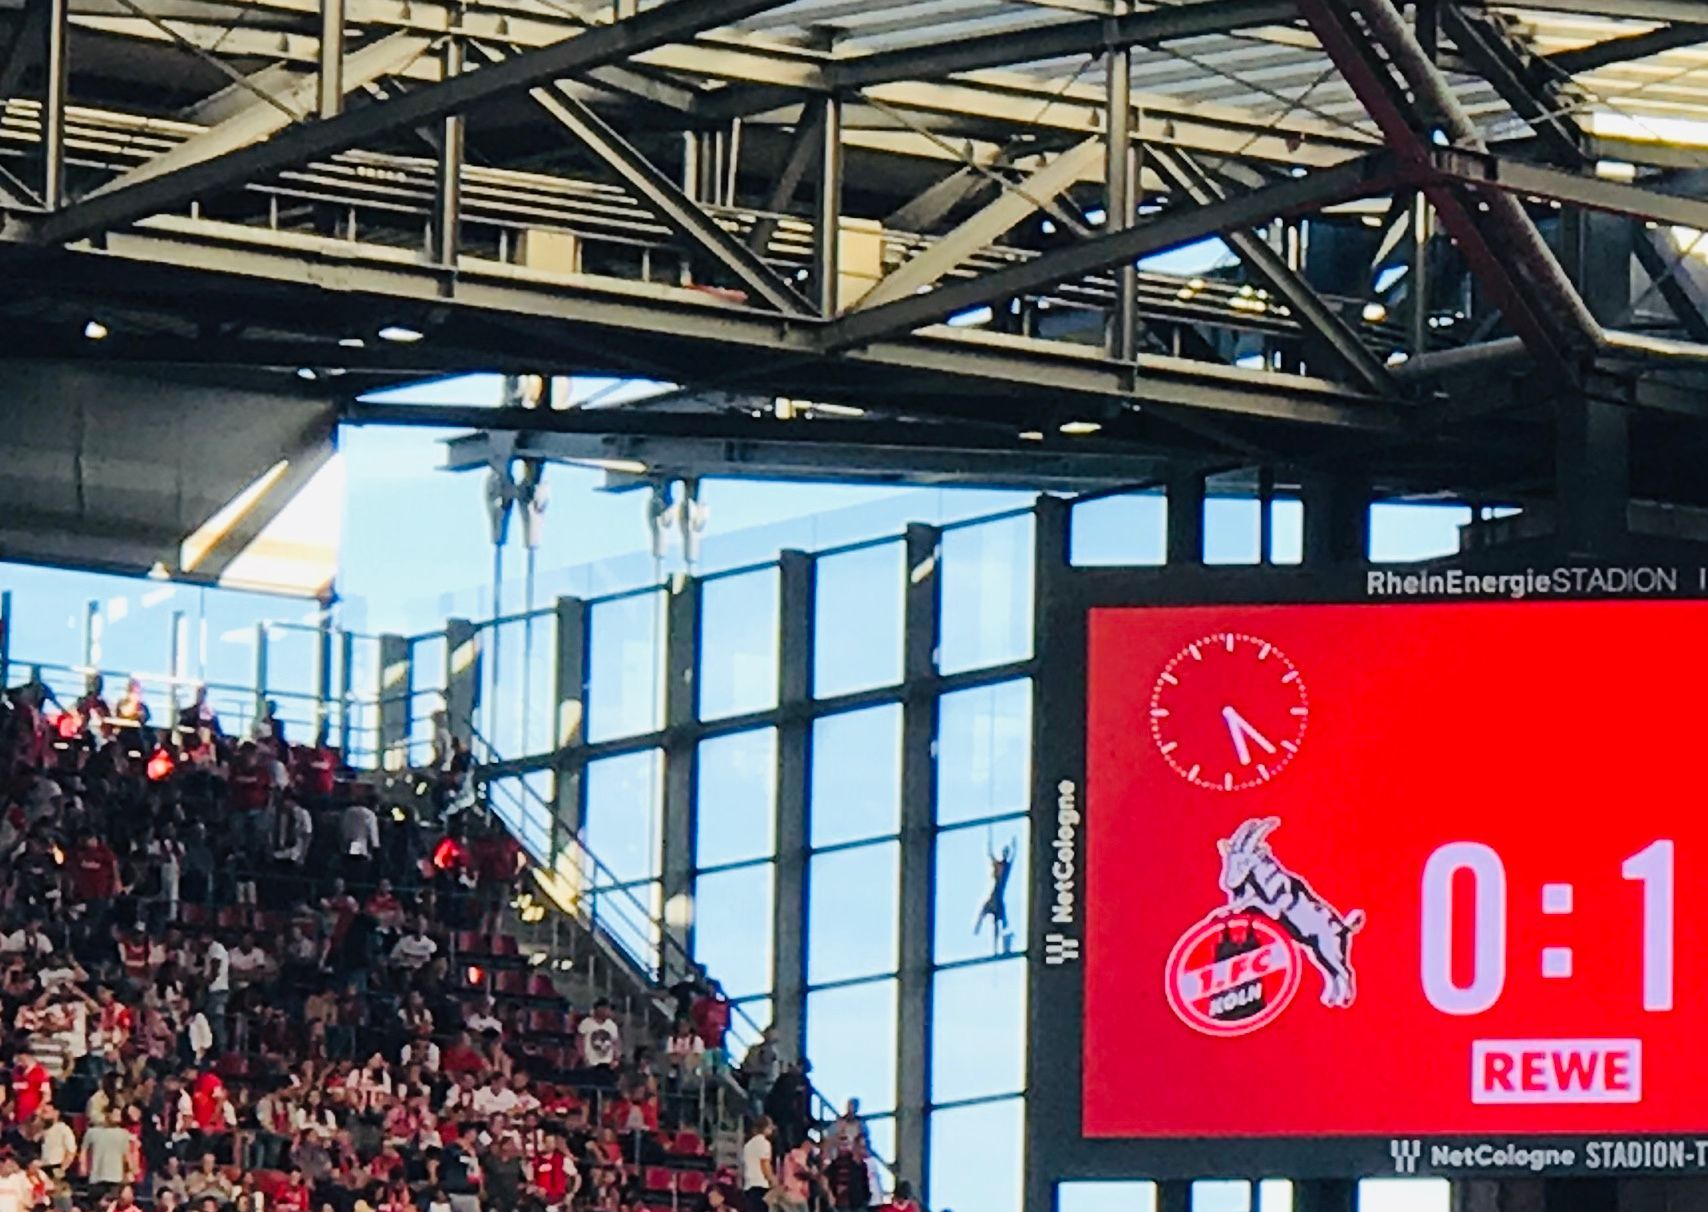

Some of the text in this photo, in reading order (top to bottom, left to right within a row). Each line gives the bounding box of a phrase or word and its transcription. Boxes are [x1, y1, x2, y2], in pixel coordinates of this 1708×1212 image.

[1367, 567, 1677, 598] RheinEnergieSTADION
[1052, 779, 1080, 922] NetCologne
[1483, 1051, 1631, 1092] REWE
[1431, 1144, 1575, 1171] NetCologne
